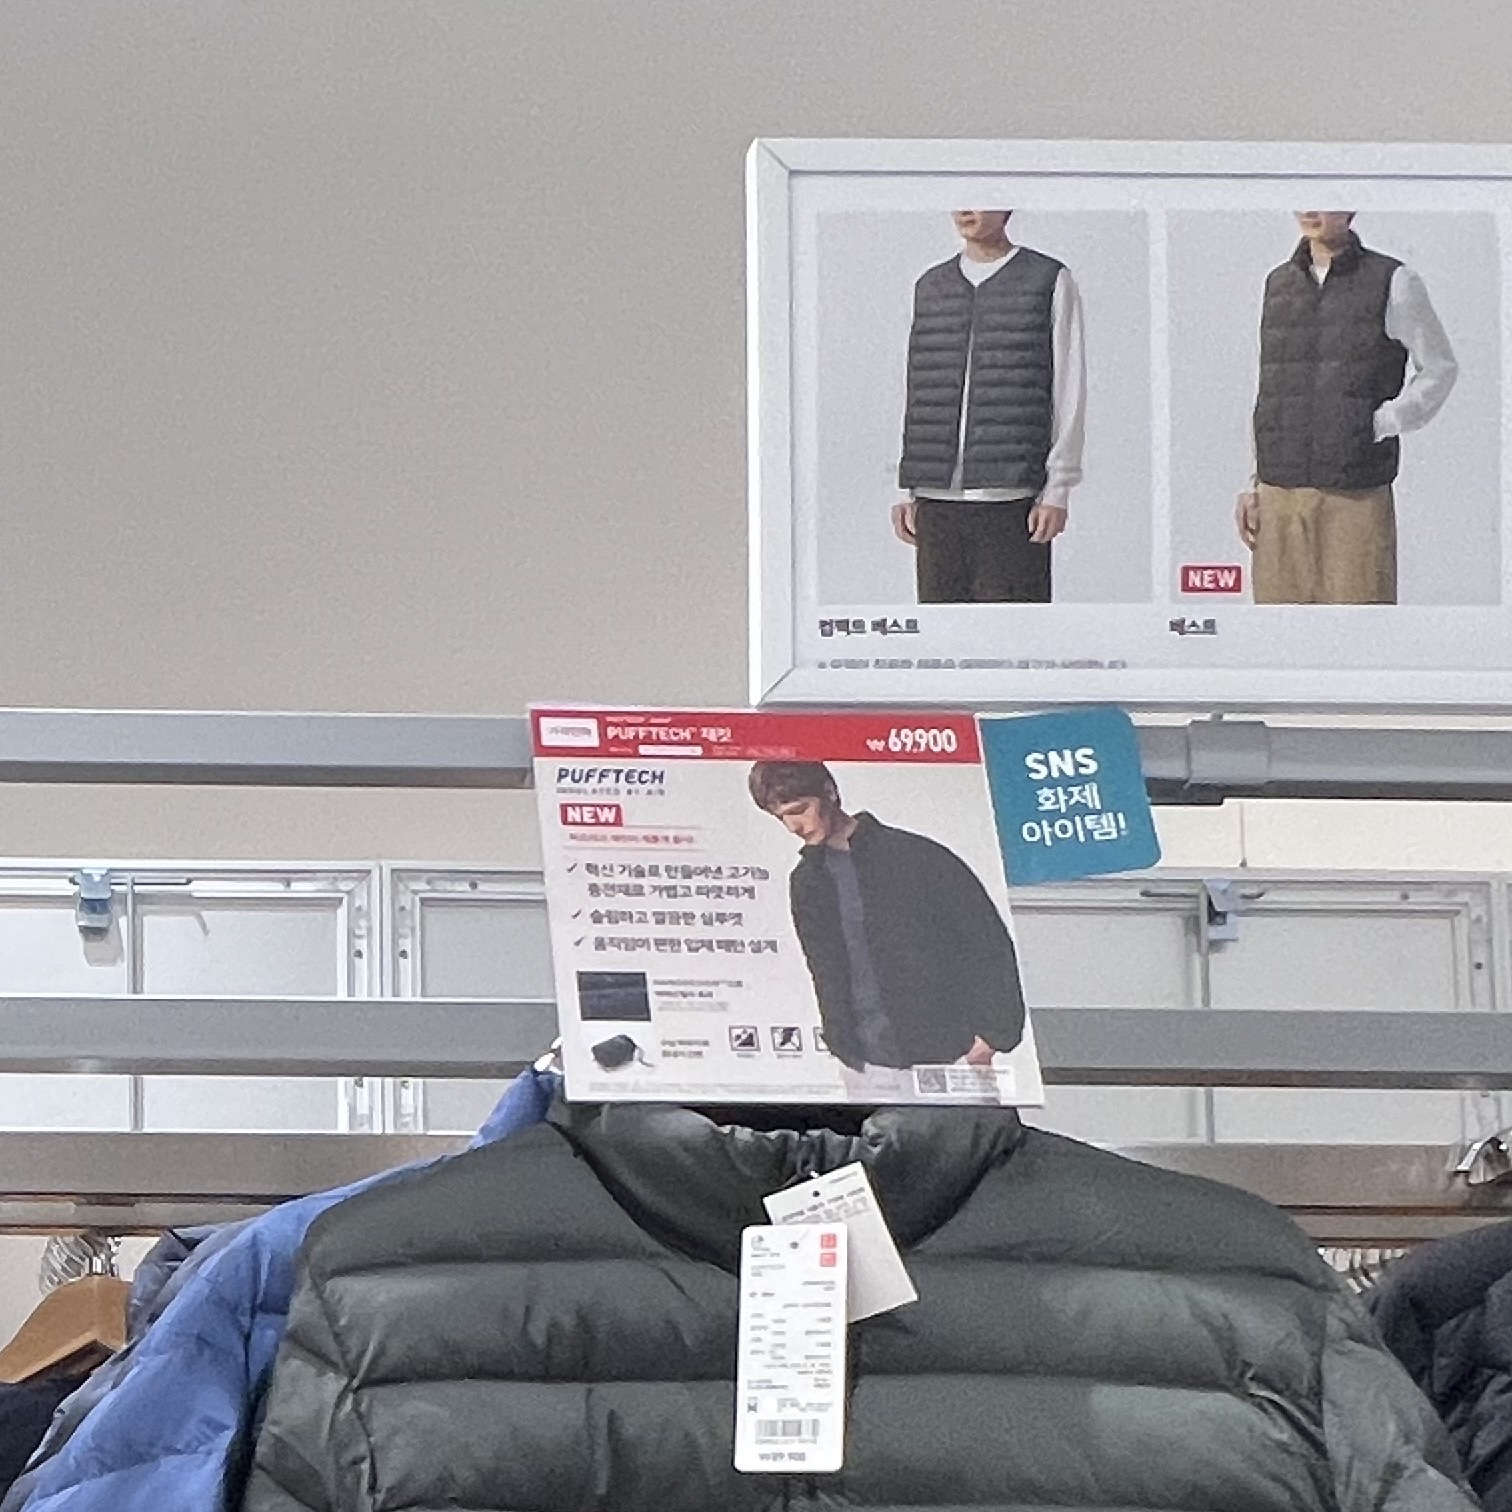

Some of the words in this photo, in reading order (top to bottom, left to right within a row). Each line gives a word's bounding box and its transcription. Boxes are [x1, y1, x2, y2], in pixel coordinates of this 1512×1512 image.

[1188, 569, 1236, 589] NEW
[557, 768, 664, 785] PUFFTECH
[1025, 748, 1098, 780] SNS
[1035, 782, 1102, 813] 화제
[566, 806, 616, 824] NEW
[1022, 812, 1126, 847] 아이템!
